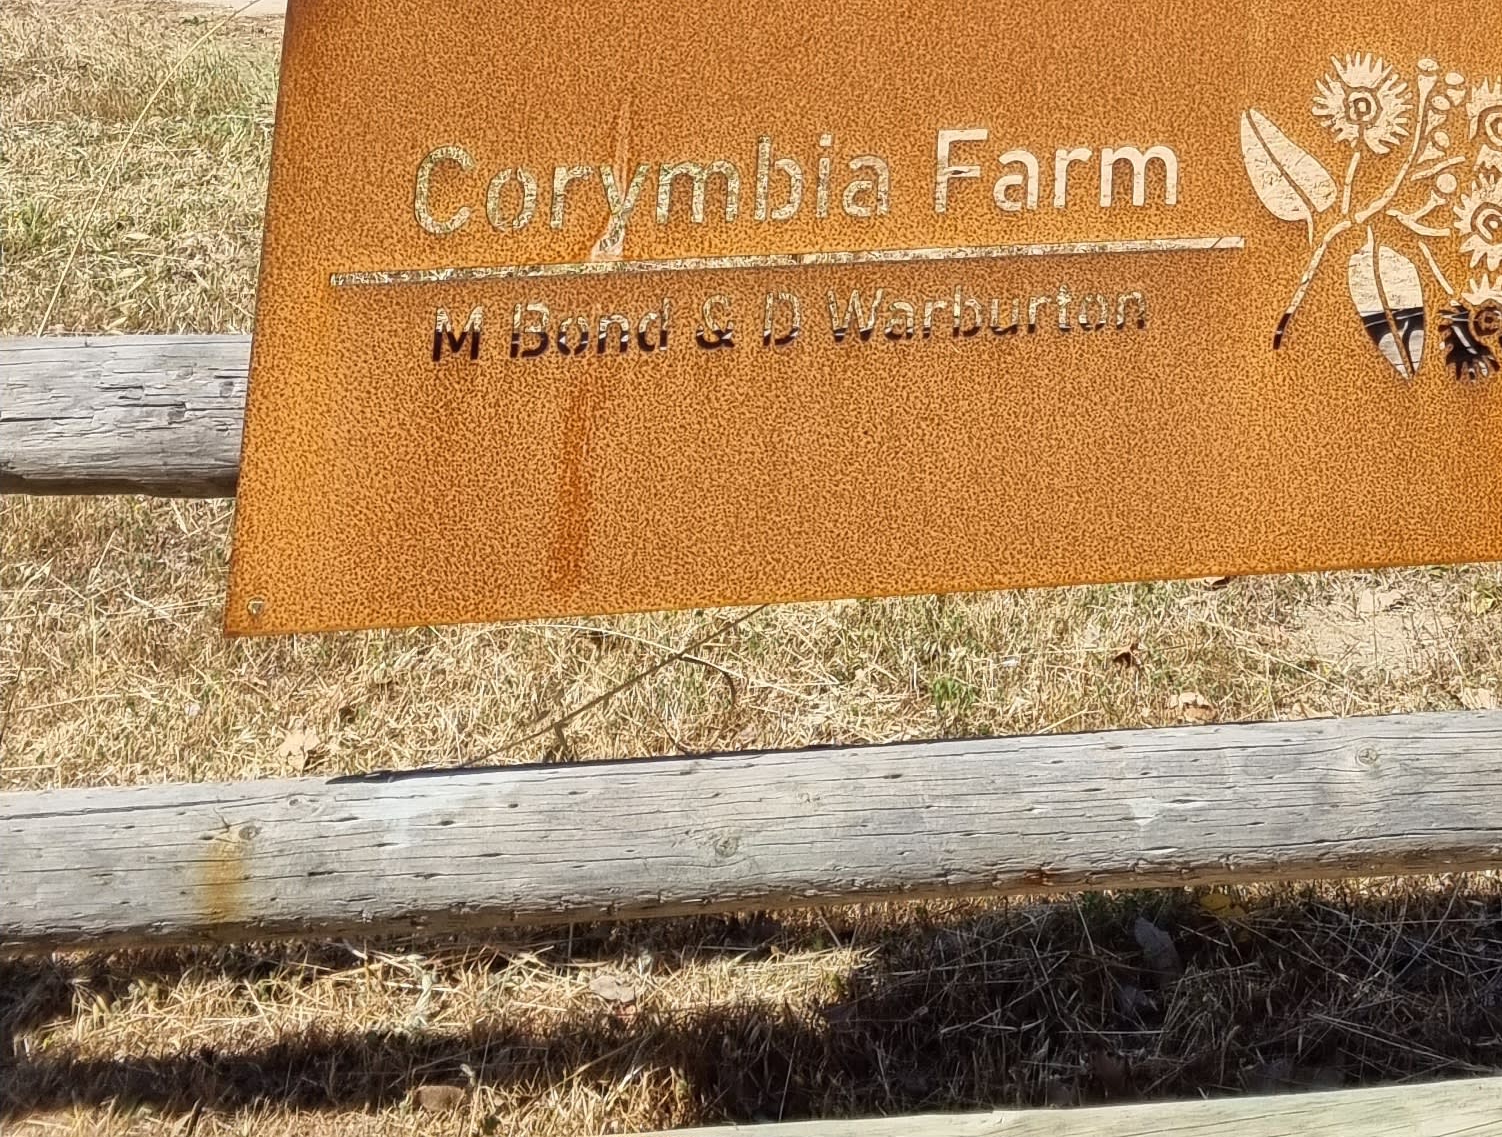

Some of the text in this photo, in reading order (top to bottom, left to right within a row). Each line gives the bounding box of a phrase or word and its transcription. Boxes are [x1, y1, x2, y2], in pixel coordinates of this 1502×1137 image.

[414, 128, 1179, 261] Corymbia Farm
[431, 284, 1146, 362] M Bond & D Warburton
